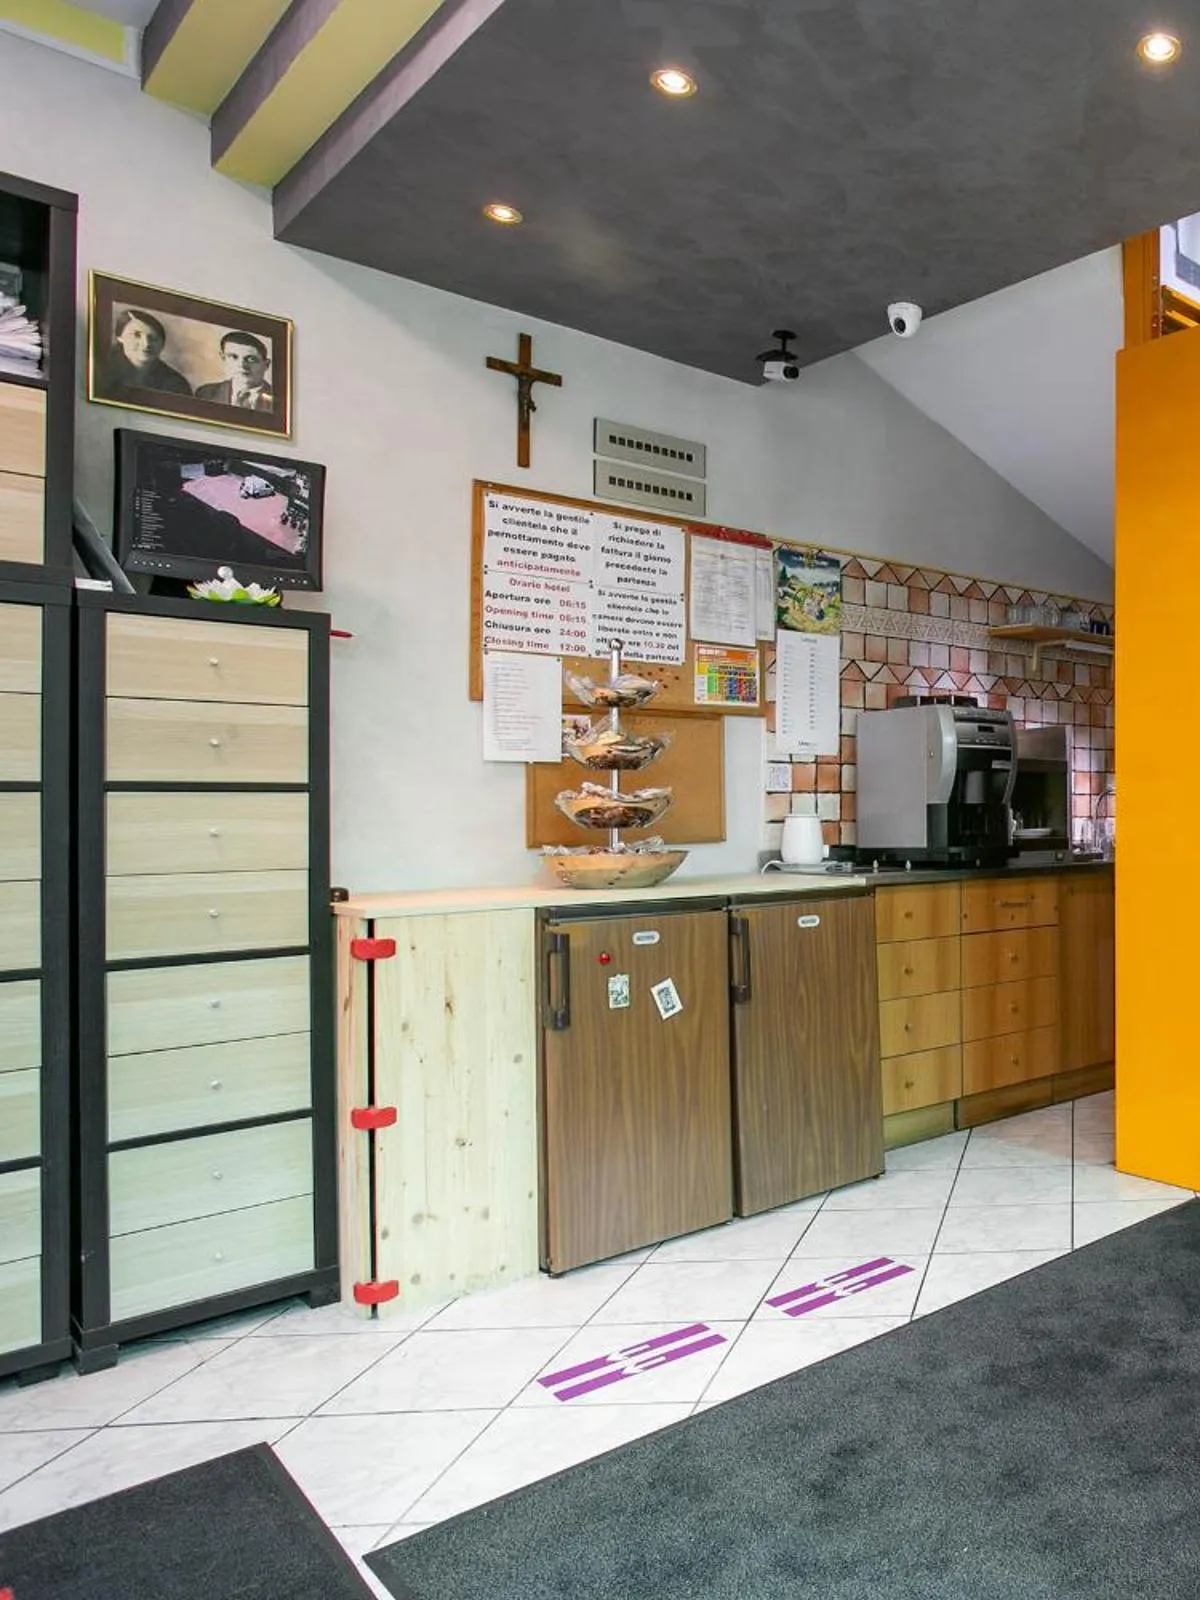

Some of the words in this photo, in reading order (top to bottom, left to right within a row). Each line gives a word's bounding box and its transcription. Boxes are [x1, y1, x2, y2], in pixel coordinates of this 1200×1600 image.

[489, 500, 499, 508] Si
[502, 503, 541, 516] avverte
[543, 510, 554, 518] la
[502, 517, 548, 530] clientela
[550, 525, 569, 535] che
[613, 521, 622, 529] Si
[652, 529, 662, 537] di
[488, 529, 564, 548] pernottamento
[567, 541, 591, 551] deve
[608, 535, 654, 549] richiedere
[656, 541, 665, 550] la
[503, 546, 538, 557] essere
[541, 551, 577, 563] pagato
[601, 545, 633, 558] fattura
[643, 554, 672, 564] giorno
[497, 559, 581, 577] anticipatamente
[605, 560, 657, 575] precedente
[509, 577, 541, 589] Orario
[545, 582, 571, 593] hotel
[485, 590, 531, 603] Apertura
[534, 597, 551, 605] ore
[485, 605, 529, 619] Opening
[531, 611, 554, 620] time
[484, 620, 531, 633] Chiusura
[534, 626, 551, 634] ore
[560, 628, 587, 638] 24:00
[484, 635, 524, 649] Closing
[526, 640, 550, 649] time
[560, 643, 587, 653] 12:00
